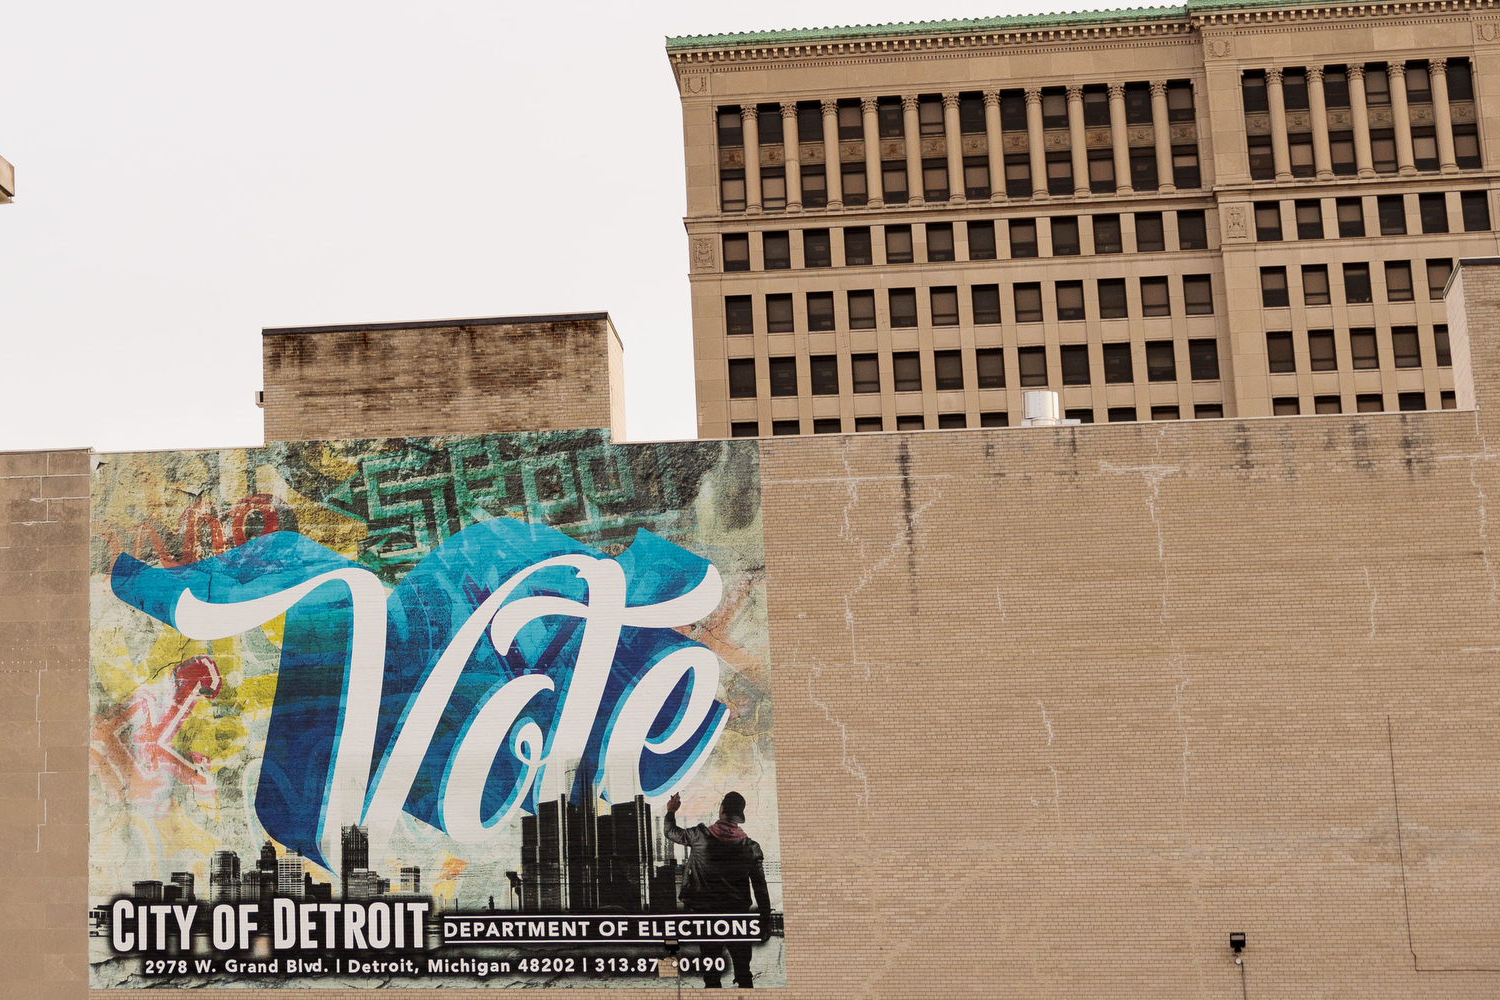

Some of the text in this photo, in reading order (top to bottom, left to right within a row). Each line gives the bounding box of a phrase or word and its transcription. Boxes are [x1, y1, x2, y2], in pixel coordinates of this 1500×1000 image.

[175, 553, 730, 862] Vote
[112, 897, 429, 952] CITY OF DETROIT
[444, 919, 761, 938] DEPARTMENT OF ELECTIONS
[145, 959, 188, 974] 2978
[194, 959, 216, 974] W.
[224, 958, 278, 974] Grand
[286, 958, 328, 973] Blvd.
[348, 958, 419, 974] Detroit,
[428, 957, 511, 977] Michigan
[517, 957, 575, 973] 48202
[595, 957, 725, 972] 313.870190
